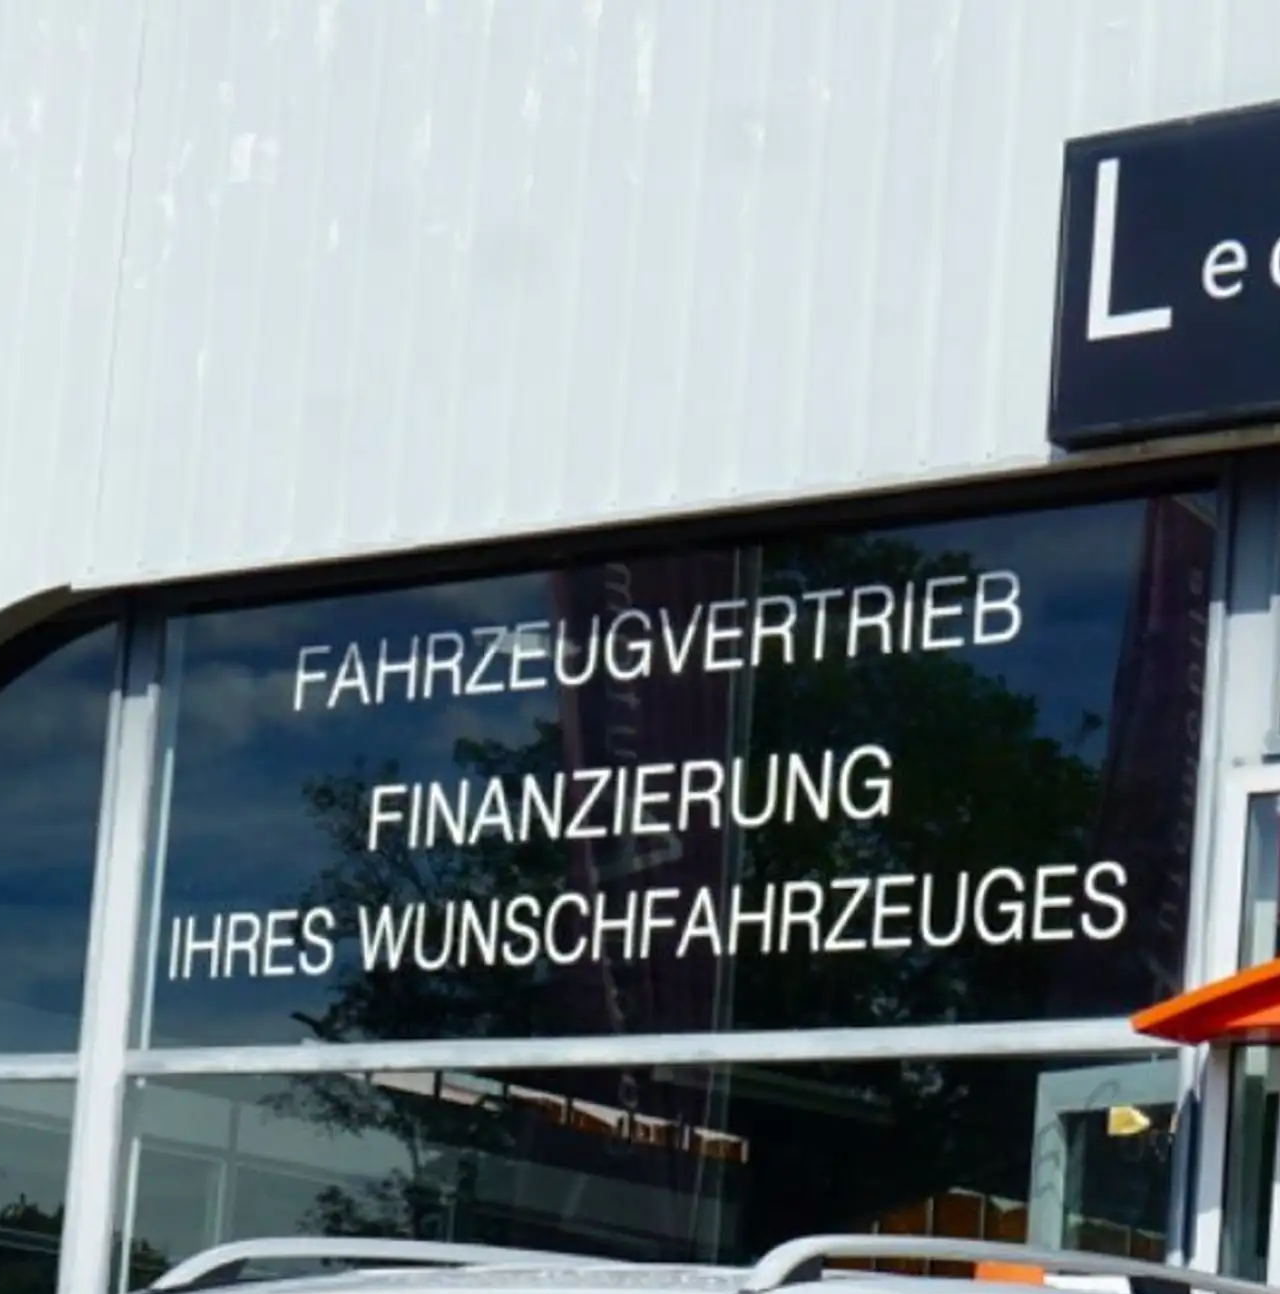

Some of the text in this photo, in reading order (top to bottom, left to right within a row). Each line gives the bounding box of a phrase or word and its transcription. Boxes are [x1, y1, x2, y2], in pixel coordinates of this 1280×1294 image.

[294, 570, 1022, 712] FAHRZEUGVERTRIEB
[368, 745, 892, 851] FINANZIERUNG
[168, 861, 1128, 980] IHRES WUNSCHFAHRZEUGES
